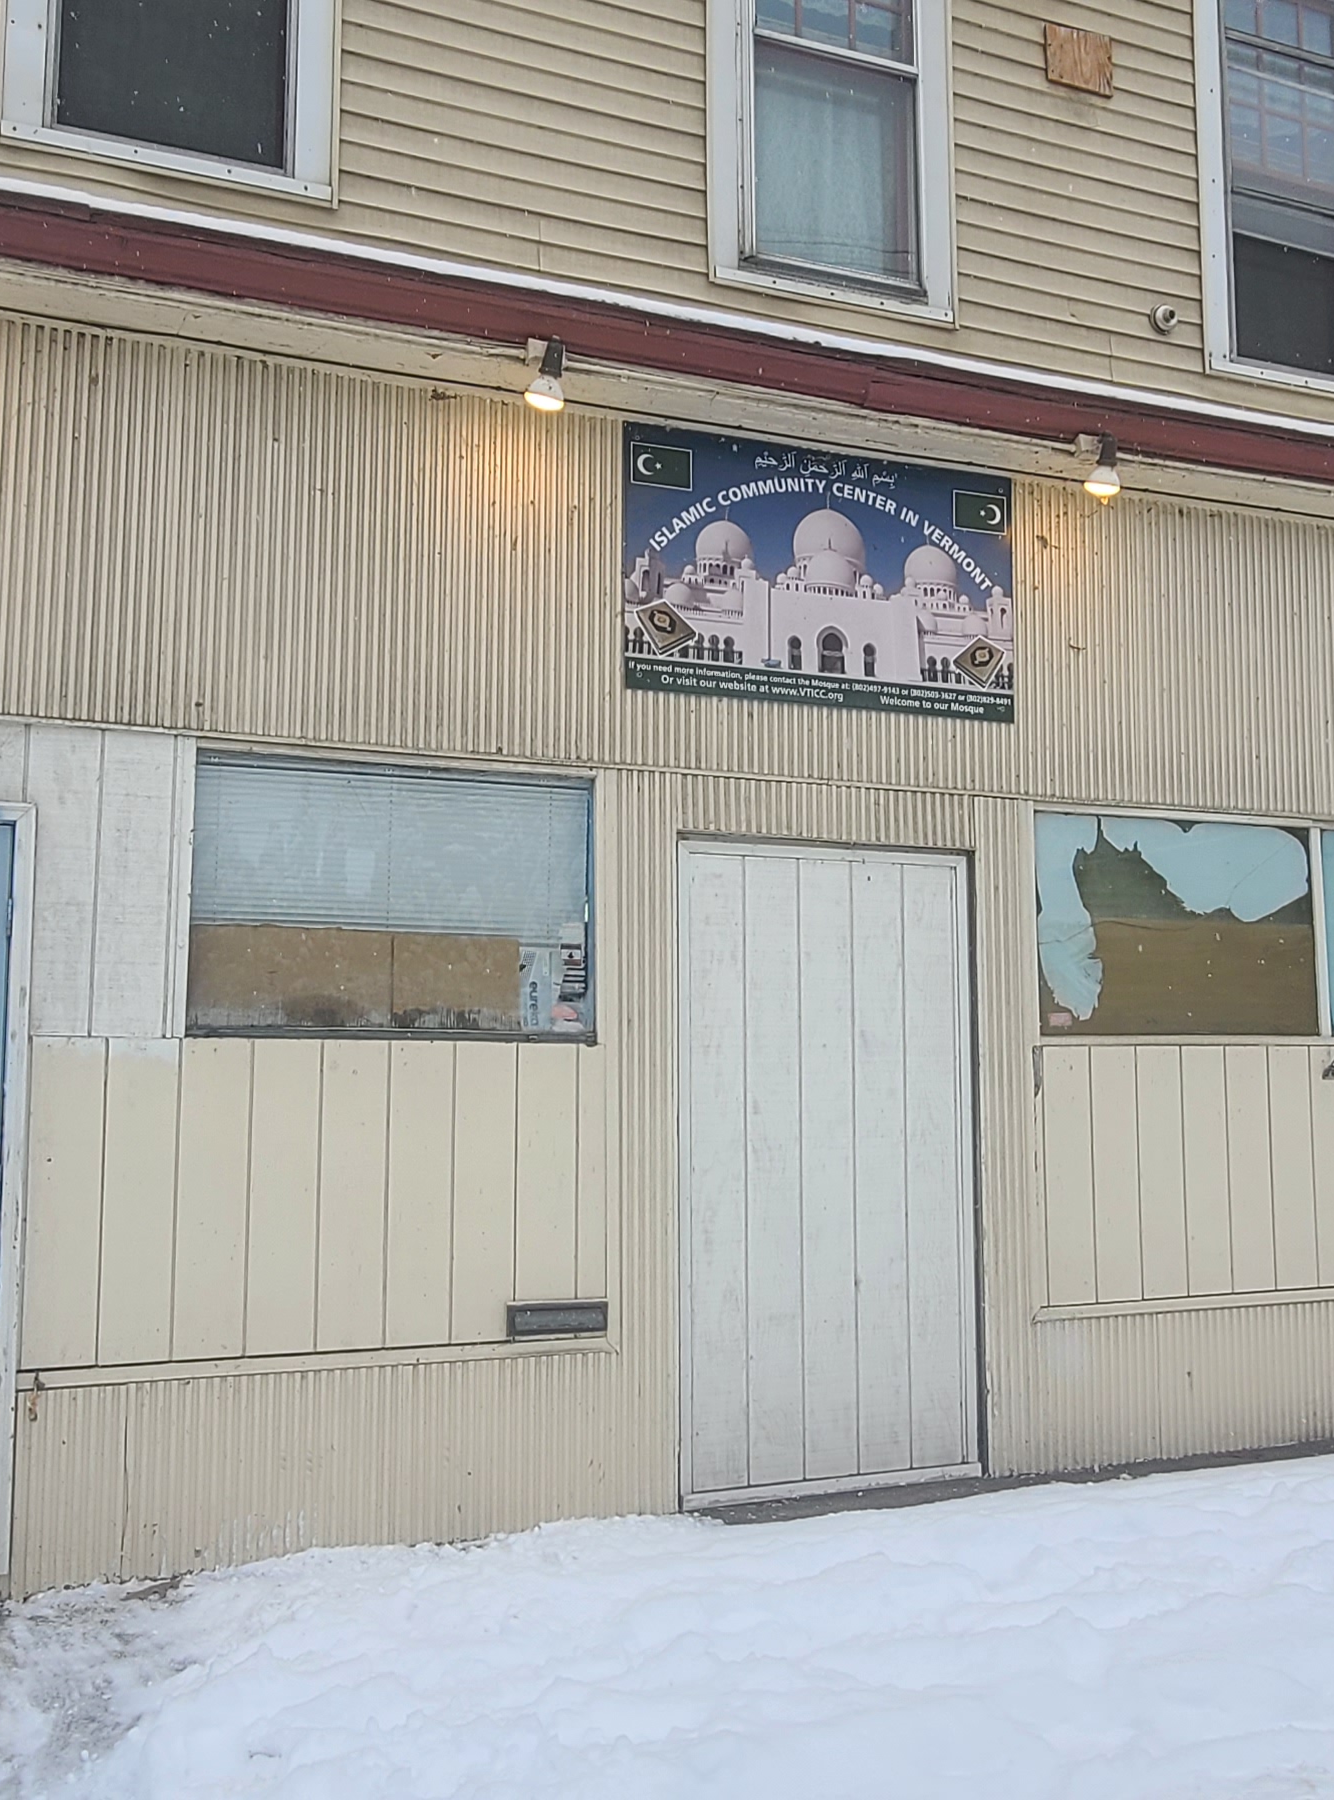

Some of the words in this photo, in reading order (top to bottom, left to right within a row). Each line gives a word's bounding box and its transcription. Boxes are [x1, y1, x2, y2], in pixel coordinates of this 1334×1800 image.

[649, 497, 716, 552] ISLAMIC
[717, 476, 827, 506] COMMUNITY
[832, 482, 897, 516] CENTER
[900, 506, 920, 528] IN
[923, 520, 992, 591] VERMONT
[628, 660, 635, 669] If
[636, 663, 651, 671] you
[653, 665, 672, 673] need
[674, 666, 694, 674] more
[696, 667, 742, 680] information,
[744, 672, 768, 682] please
[769, 675, 796, 685] contact
[797, 677, 810, 686] the
[811, 678, 839, 690] Mosque
[661, 674, 674, 684] Or
[676, 676, 697, 686] visit
[699, 679, 717, 688] our
[718, 680, 756, 692] website
[759, 683, 769, 693] at
[771, 686, 844, 703] www.VTICC.org
[879, 695, 920, 708] Welcome
[922, 699, 932, 708] to
[934, 701, 949, 711] our
[950, 702, 985, 715] Mosque
